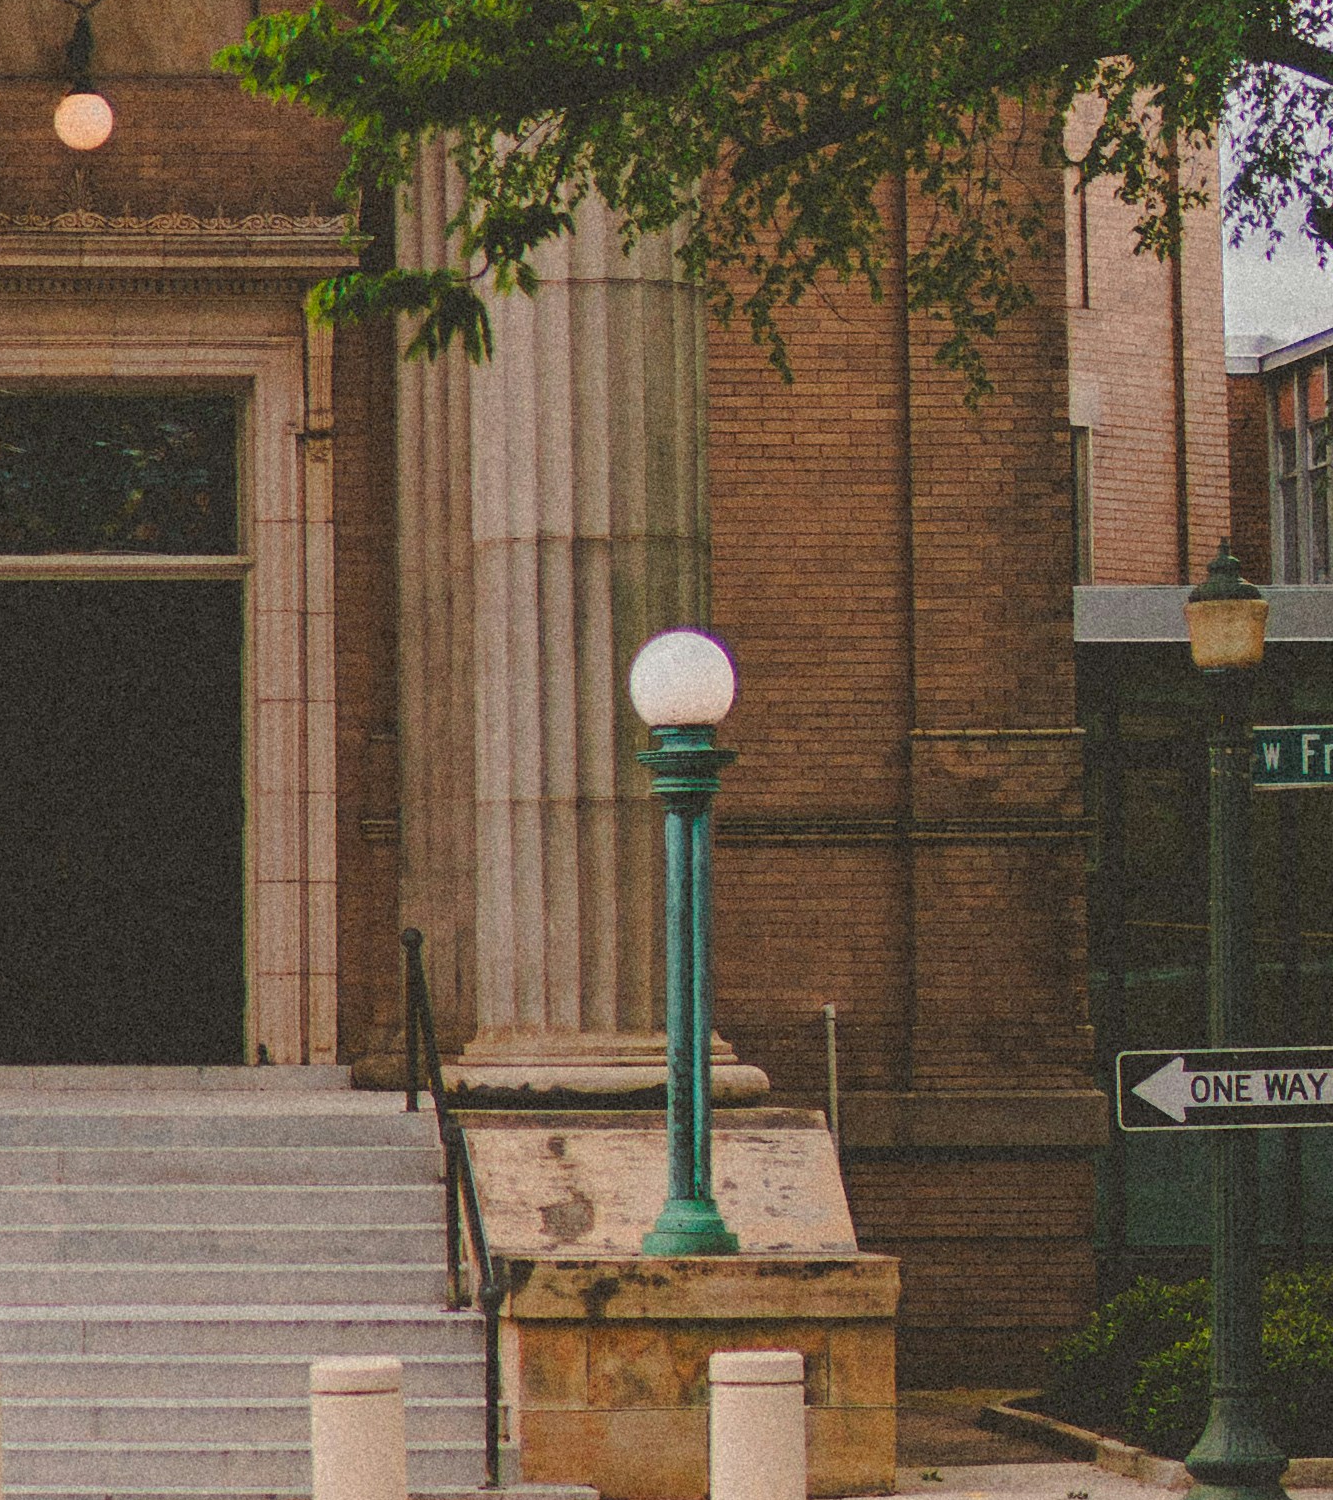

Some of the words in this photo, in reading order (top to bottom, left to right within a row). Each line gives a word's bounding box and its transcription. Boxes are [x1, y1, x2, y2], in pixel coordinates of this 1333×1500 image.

[1262, 742, 1281, 771] W
[1190, 1074, 1253, 1103] ONE
[1264, 1072, 1329, 1102] WAY
